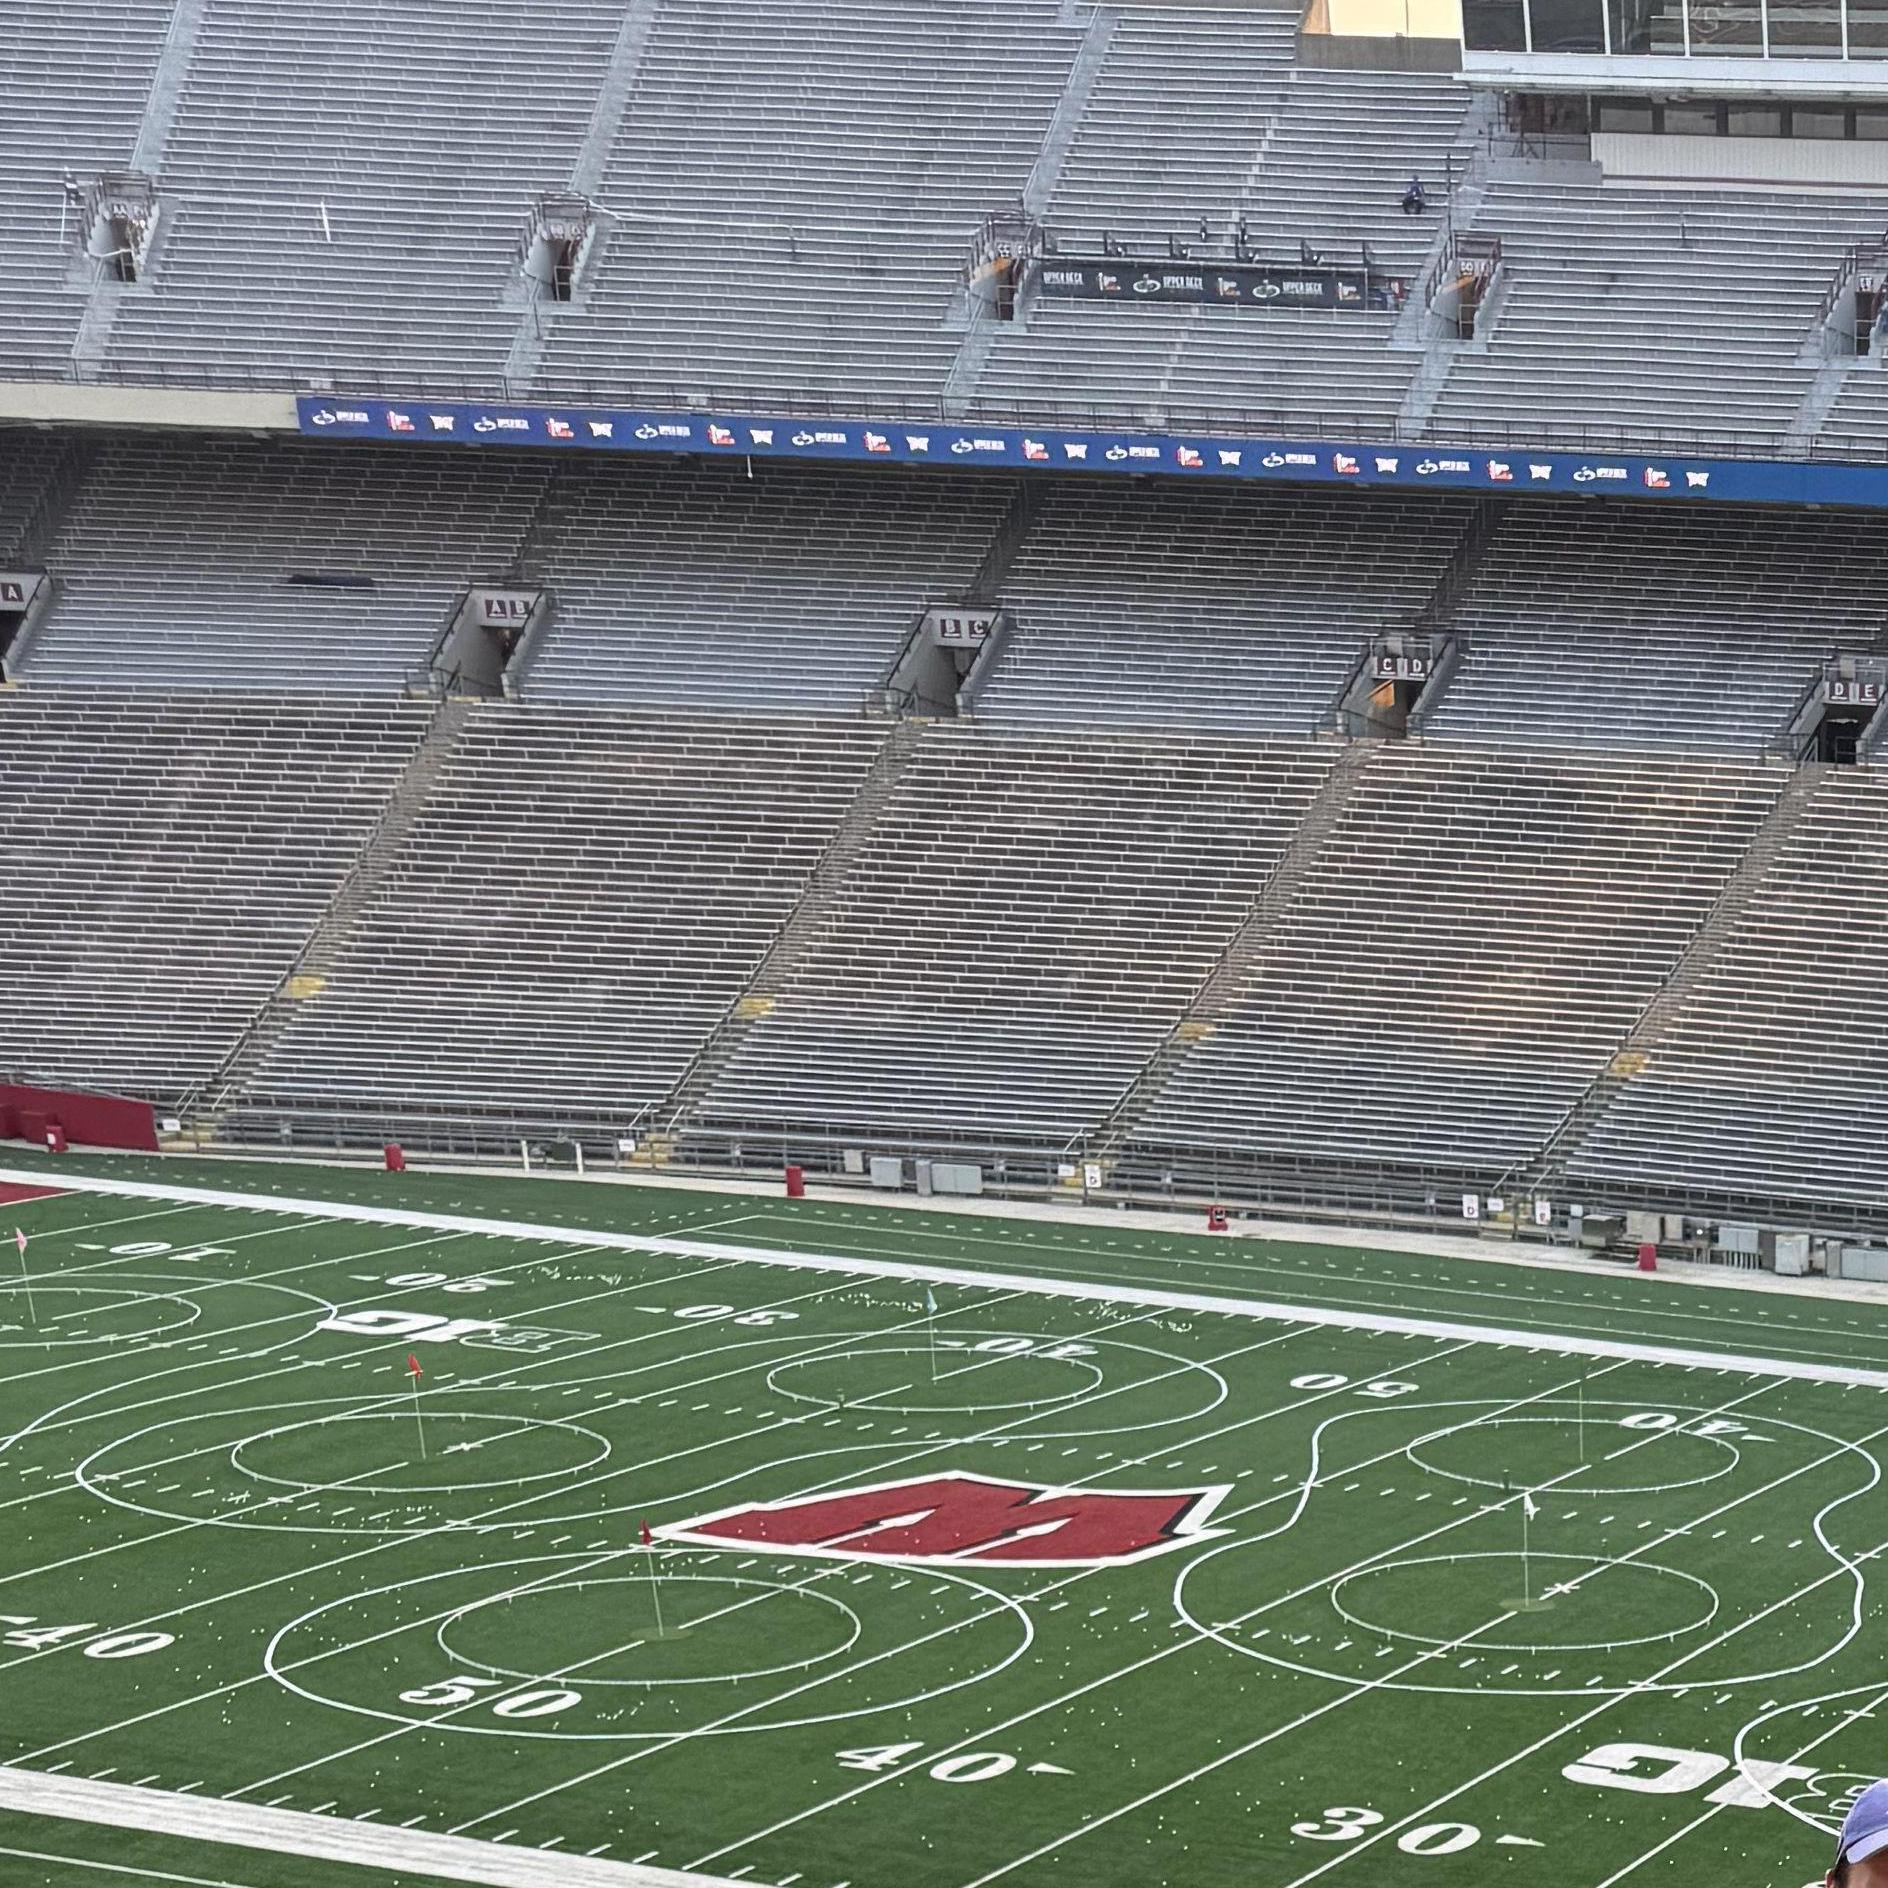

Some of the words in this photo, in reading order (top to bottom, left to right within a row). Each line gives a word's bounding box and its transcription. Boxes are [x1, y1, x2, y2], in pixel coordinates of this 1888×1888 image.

[385, 1272, 513, 1293] 20
[672, 1303, 799, 1326] 30
[973, 1336, 1099, 1359] 40
[1289, 1373, 1420, 1400] 50
[1619, 1413, 1748, 1438] 40
[2, 1623, 175, 1659] 40
[399, 1676, 582, 1718] 50
[834, 1740, 1016, 1784] 40
[1289, 1806, 1480, 1855] 30
